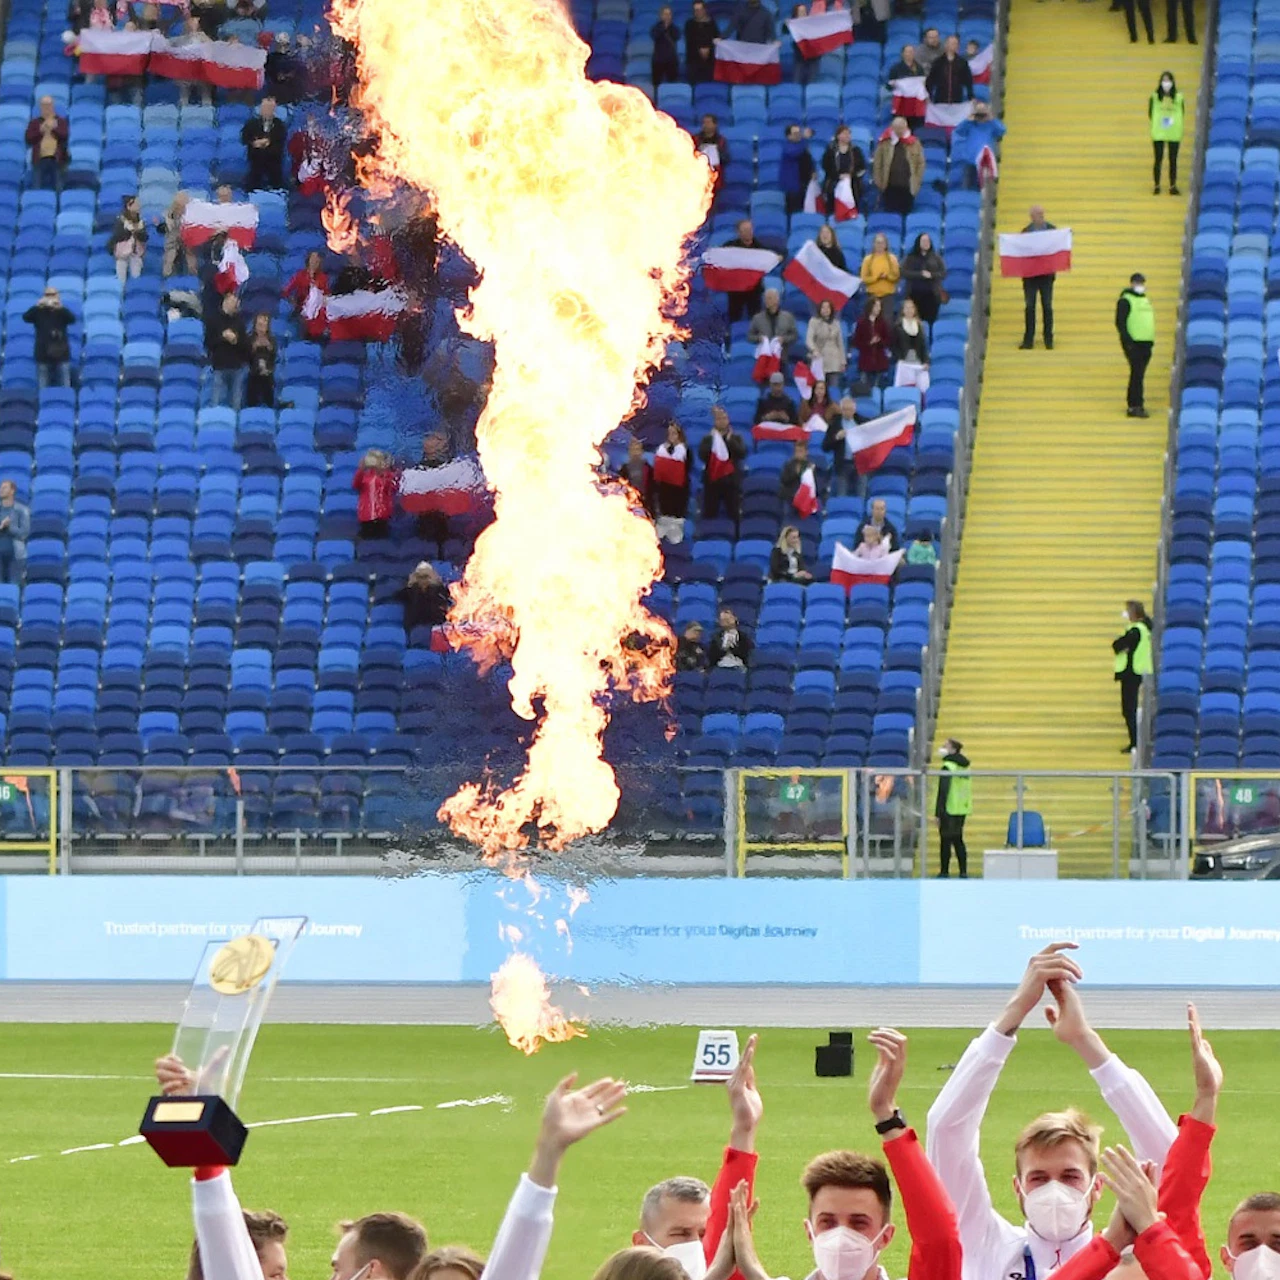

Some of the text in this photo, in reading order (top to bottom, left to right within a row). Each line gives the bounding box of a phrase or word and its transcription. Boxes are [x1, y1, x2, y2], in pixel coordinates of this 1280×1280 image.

[104, 920, 157, 937] Trusted
[308, 922, 363, 939] Journey
[718, 923, 761, 939] Digital
[1019, 925, 1073, 940] Trusted
[1074, 926, 1123, 943] partner
[1125, 926, 1145, 940] for
[1147, 928, 1181, 943] your
[1182, 926, 1225, 942] Digital
[702, 1044, 731, 1066] 55
